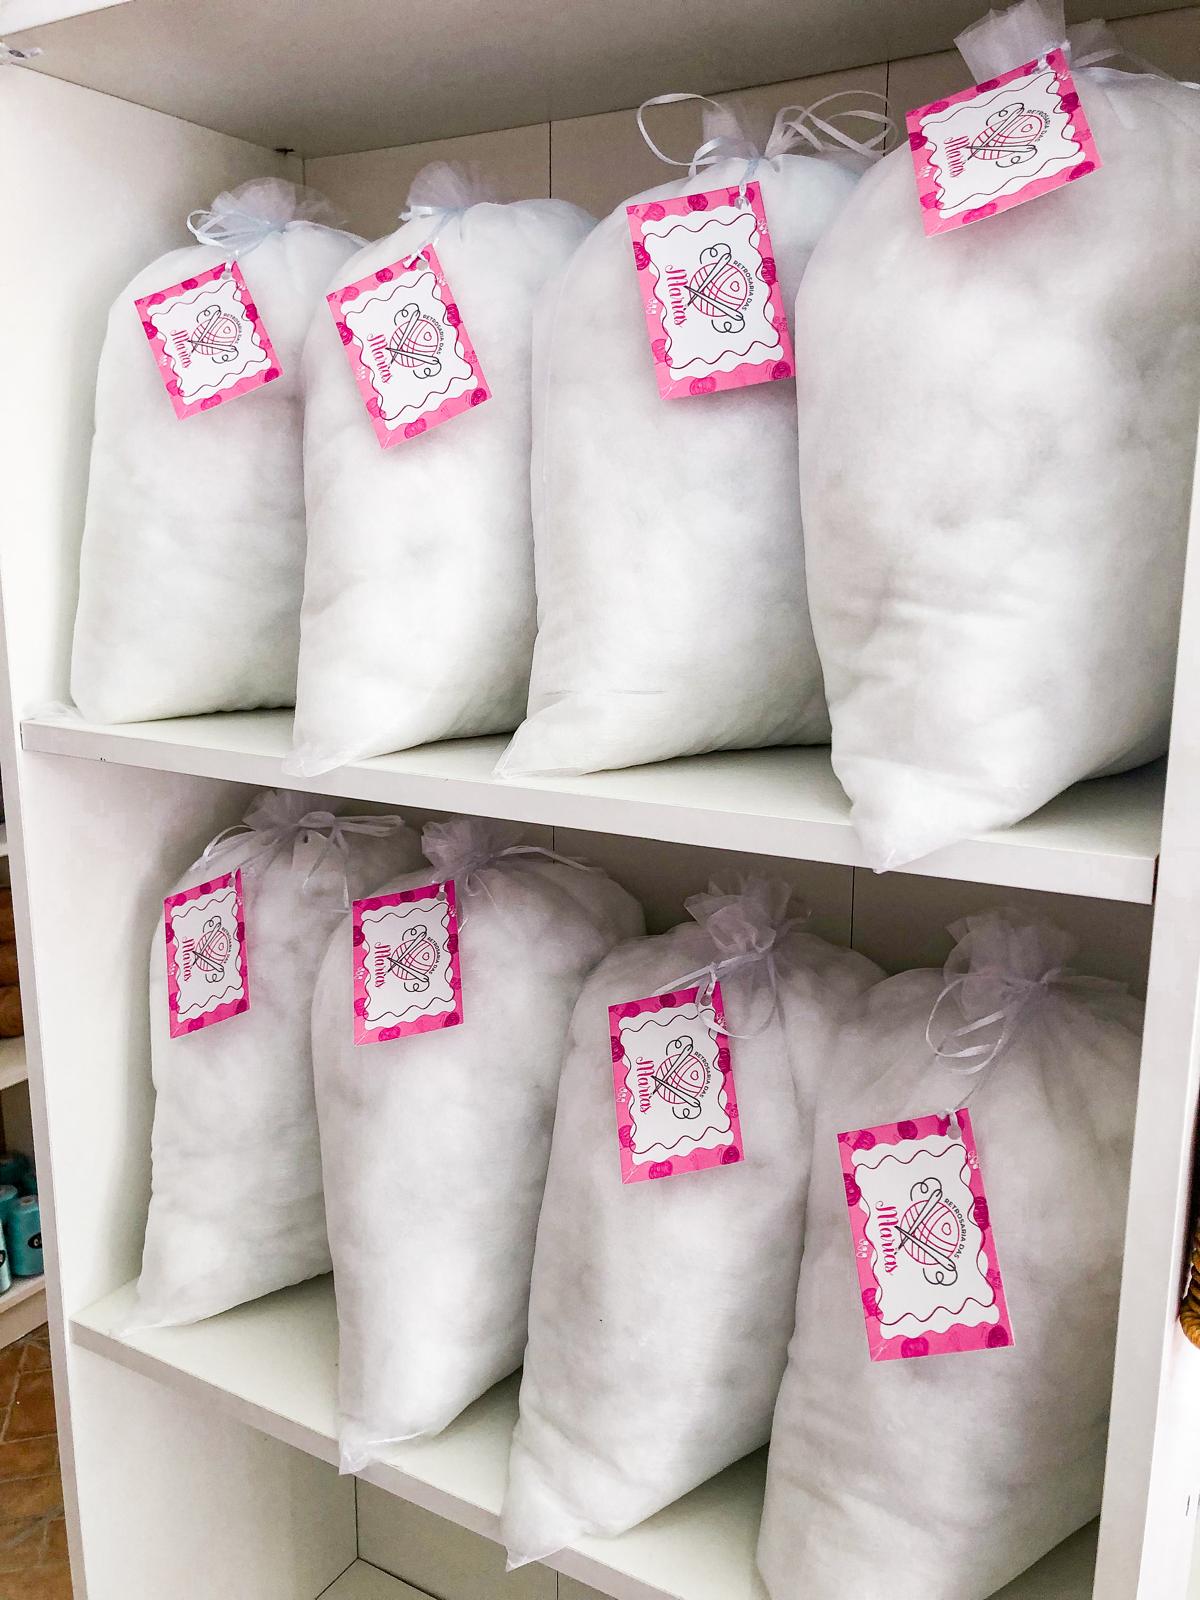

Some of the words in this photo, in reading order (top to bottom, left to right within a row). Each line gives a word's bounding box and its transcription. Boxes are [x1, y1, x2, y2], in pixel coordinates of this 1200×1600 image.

[665, 265, 688, 328] Marias
[733, 260, 754, 297] RETROSARIA
[742, 298, 752, 311] DAS
[367, 333, 392, 384] Marias
[374, 942, 391, 989] Marias
[636, 1057, 655, 1114] Marias
[694, 1051, 711, 1084] RETROSARIA
[700, 1085, 709, 1098] DAS
[875, 1200, 898, 1276] Marias
[944, 1198, 967, 1242] RETROSARIA
[953, 1243, 965, 1259] DAS
